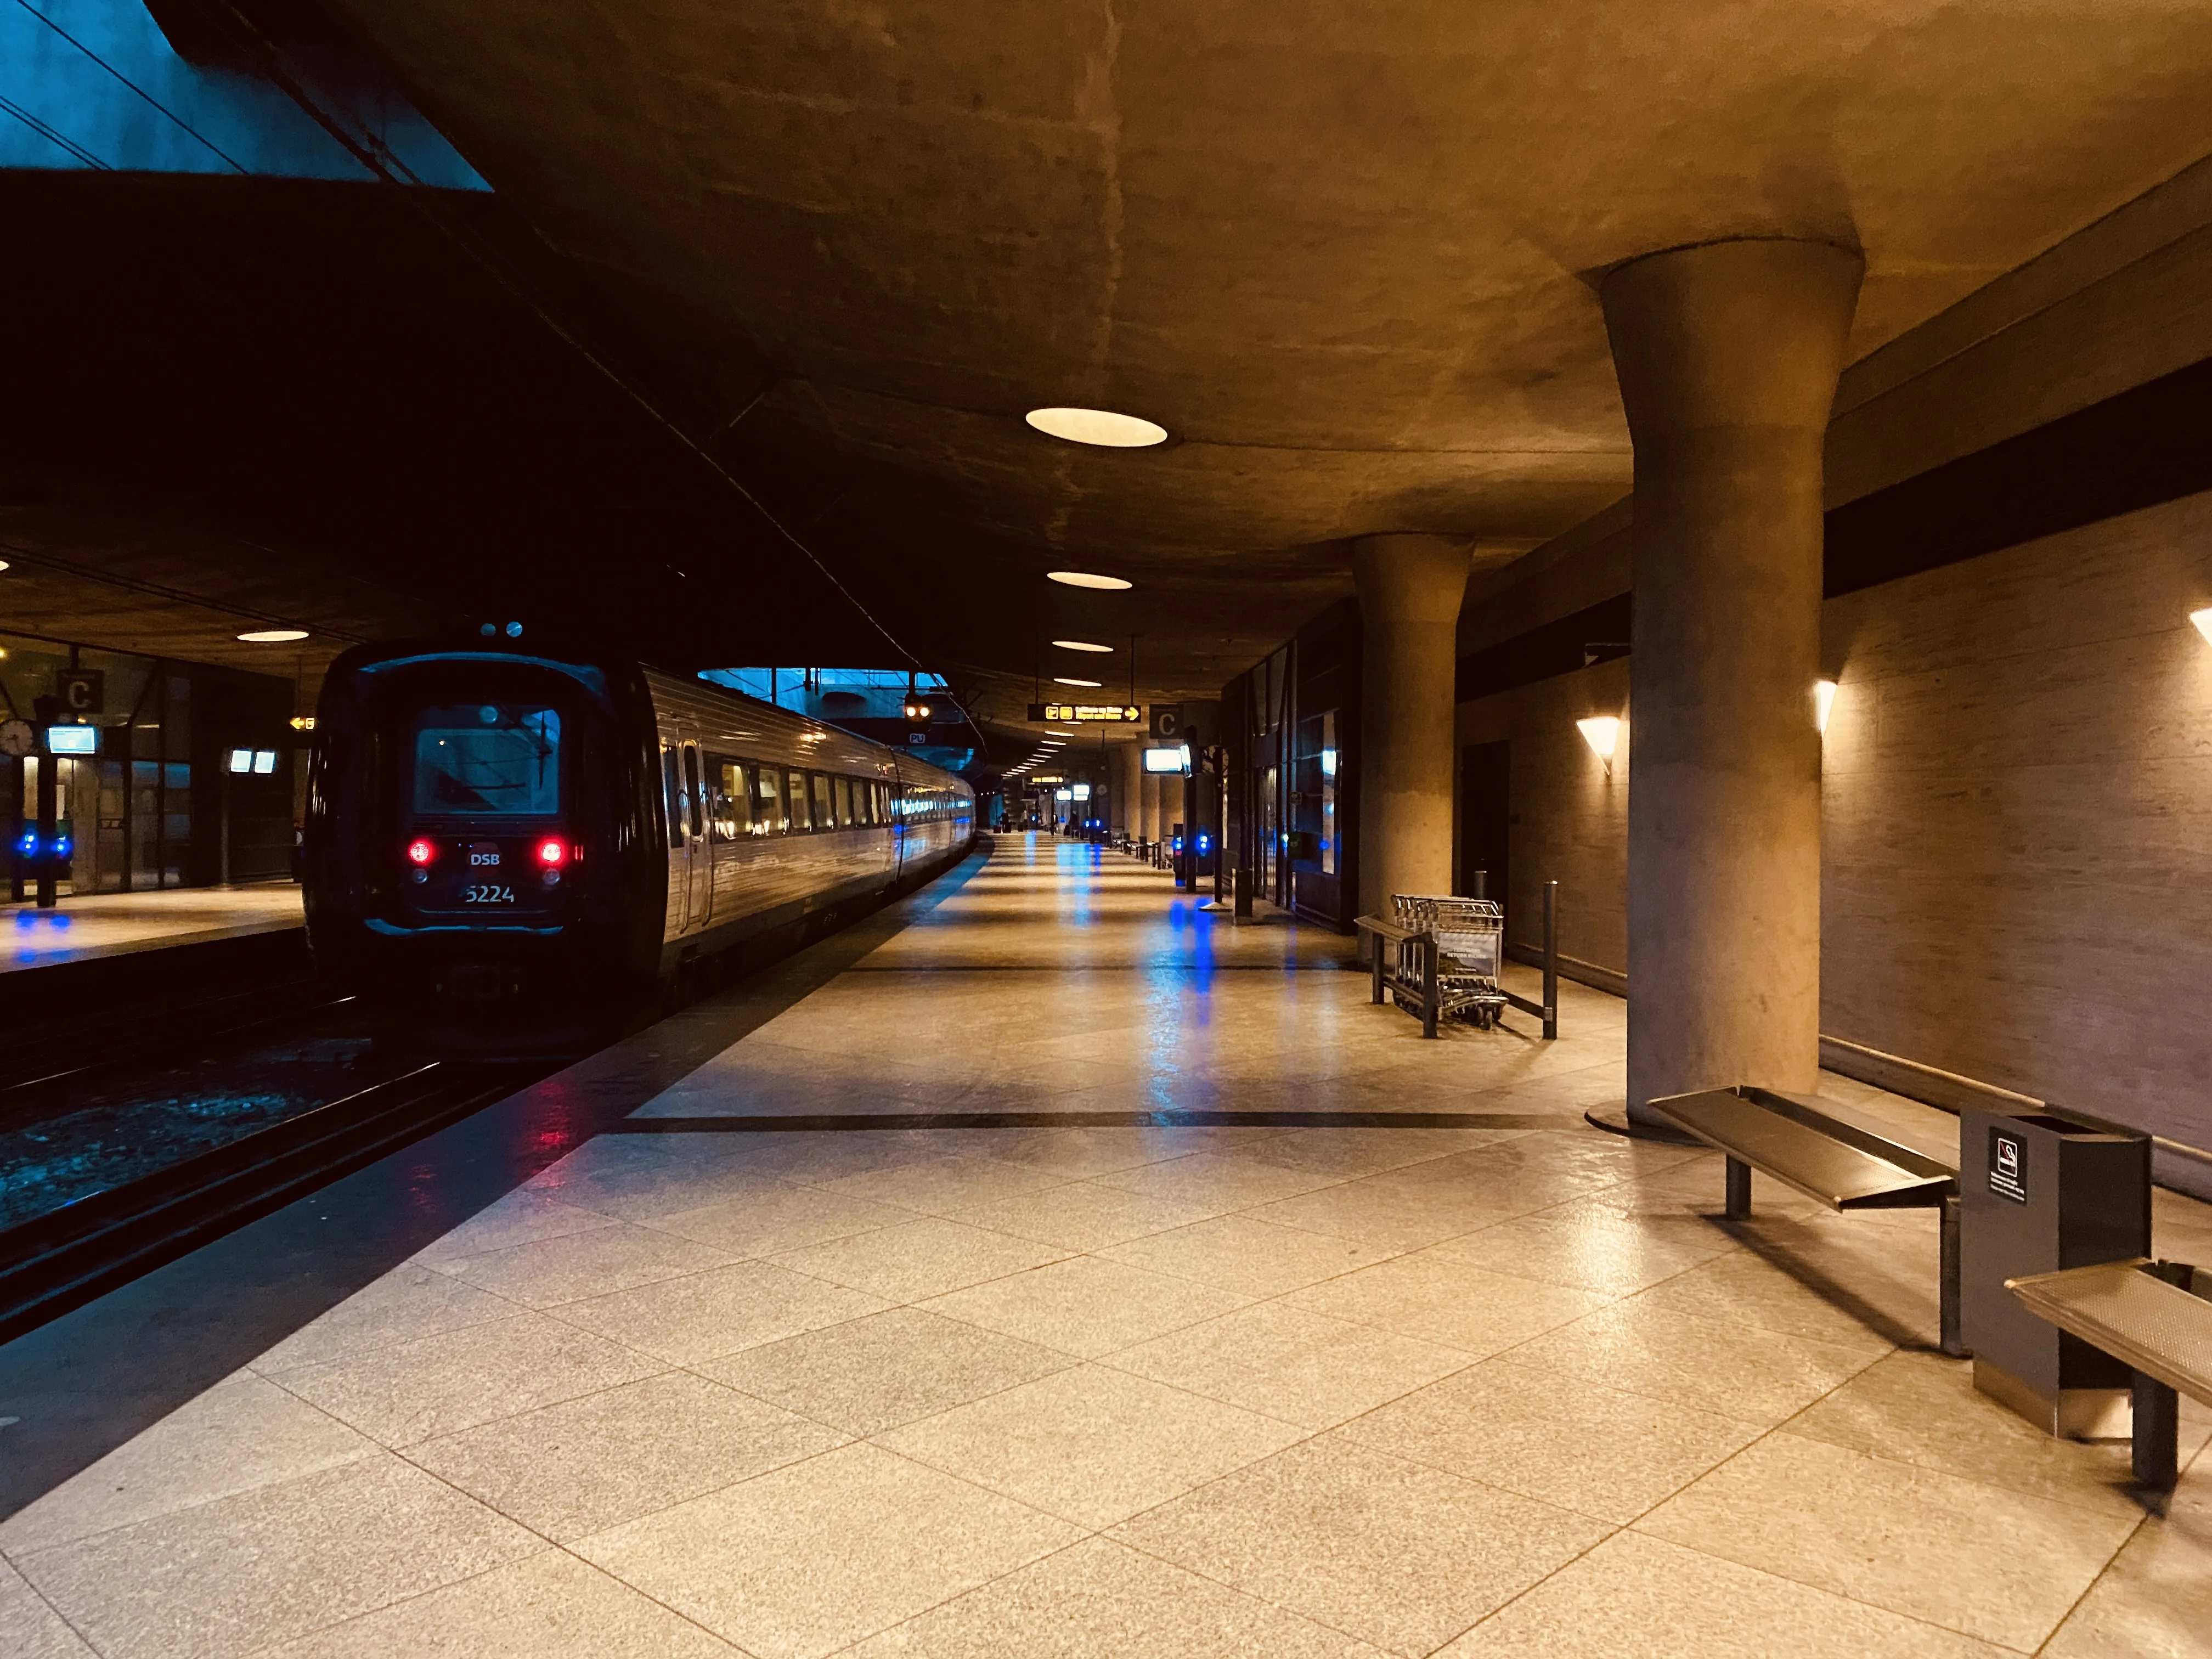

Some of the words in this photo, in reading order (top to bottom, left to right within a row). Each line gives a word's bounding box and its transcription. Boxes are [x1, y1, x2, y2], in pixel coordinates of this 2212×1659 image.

[69, 681, 91, 708] C
[1159, 713, 1175, 736] C
[911, 734, 924, 742] PU
[471, 854, 500, 865] DSB
[465, 885, 514, 902] 5224
